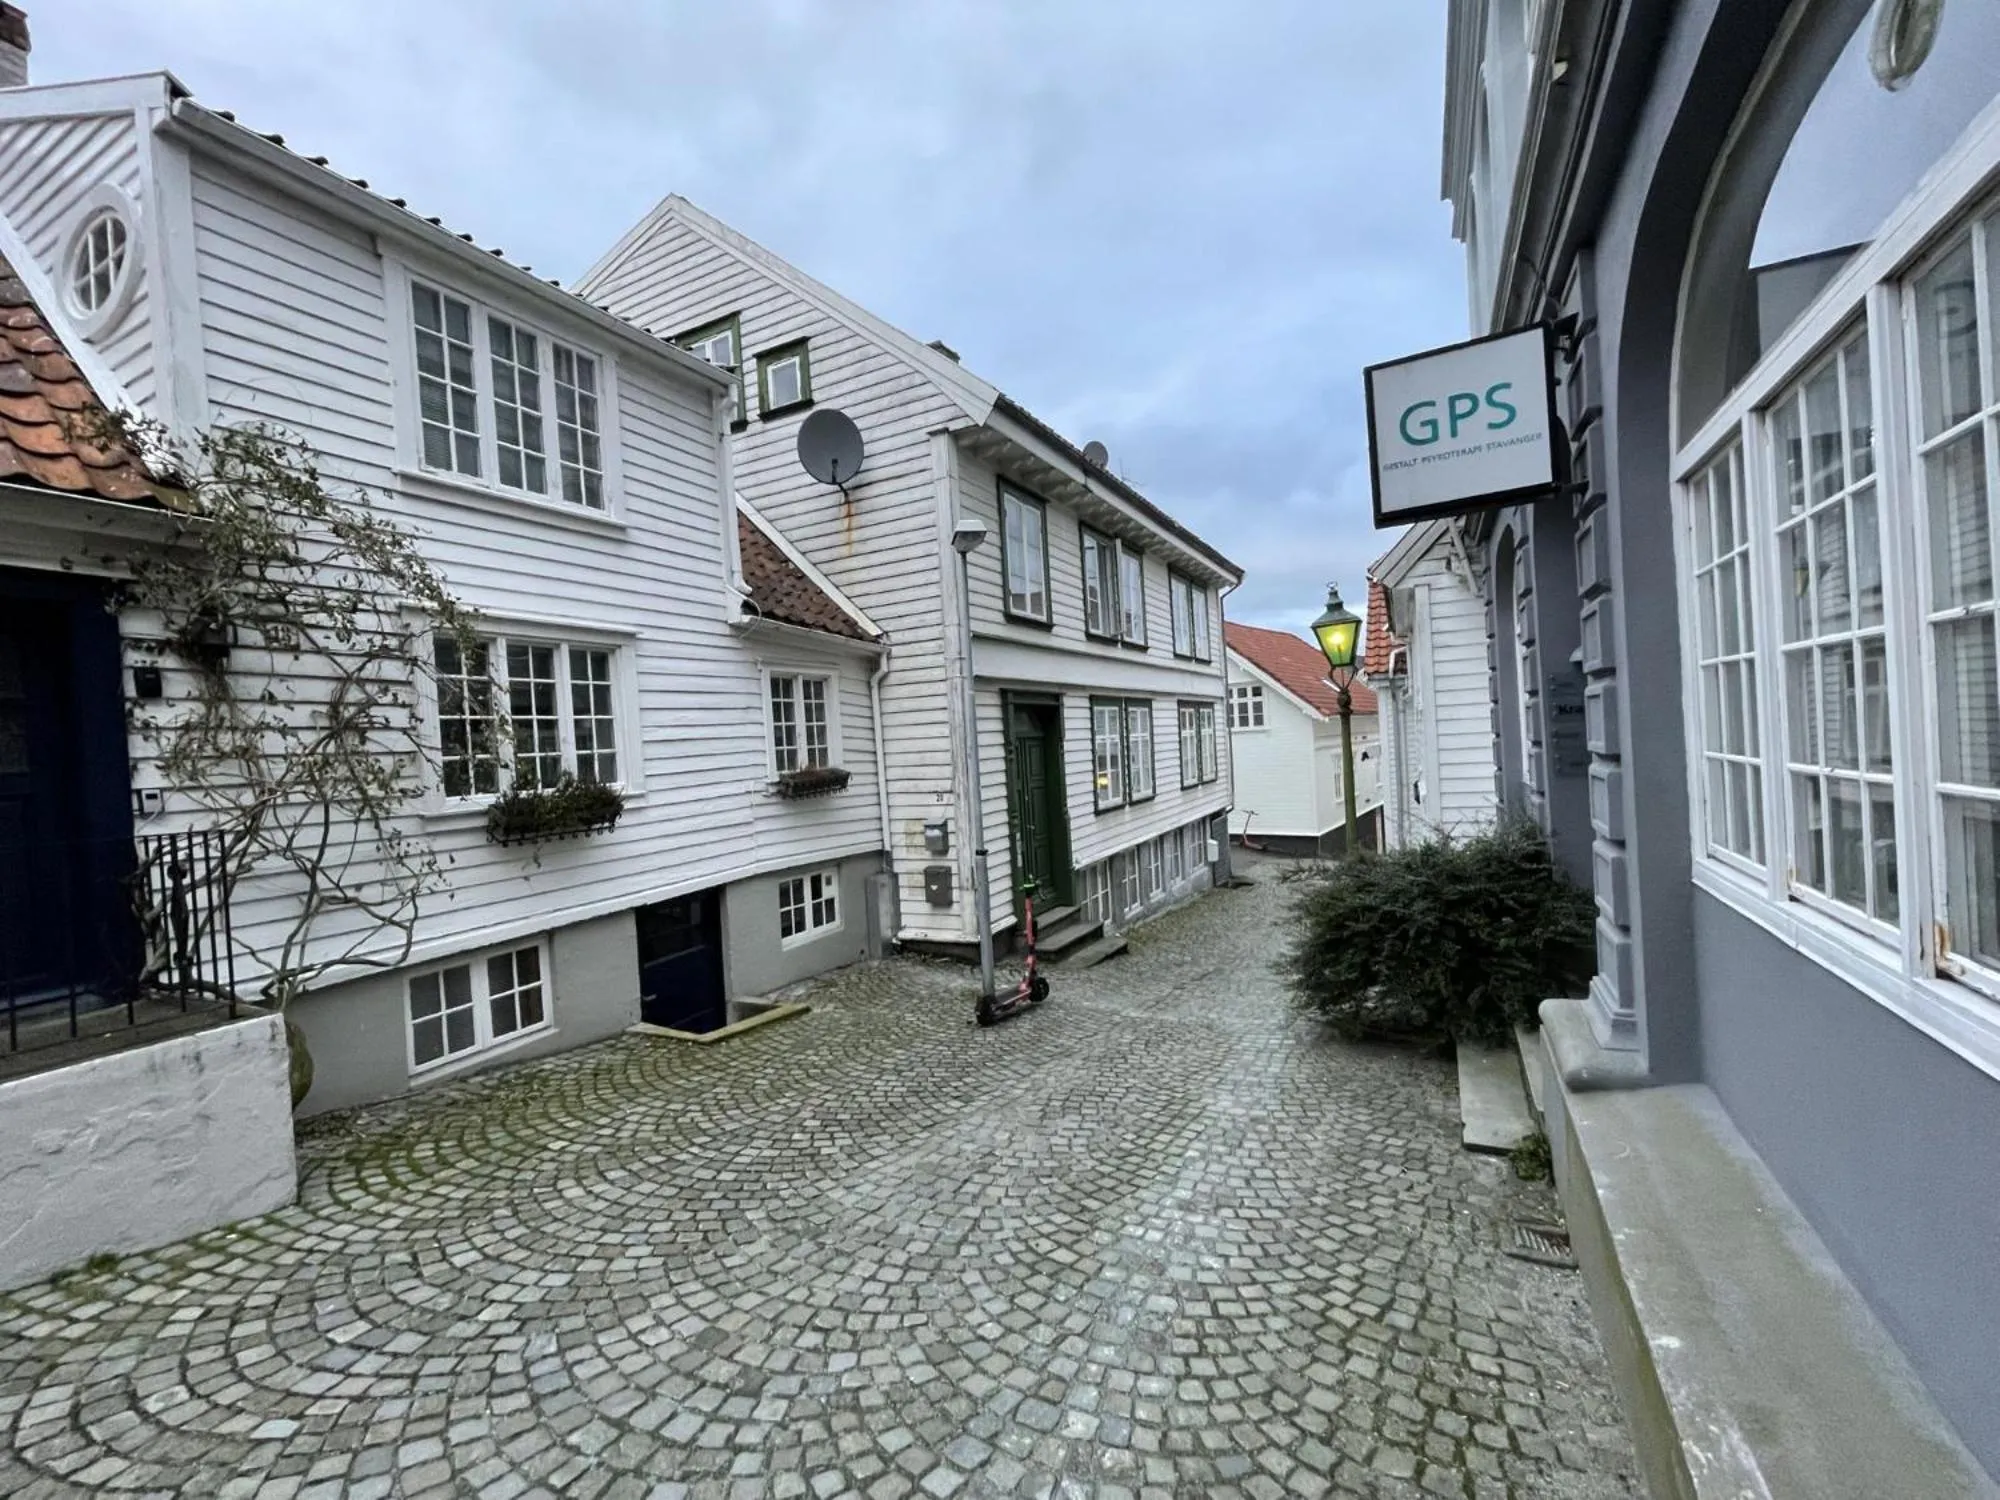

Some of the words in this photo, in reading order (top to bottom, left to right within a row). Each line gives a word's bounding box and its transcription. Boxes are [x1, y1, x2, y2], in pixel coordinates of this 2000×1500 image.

[1399, 382, 1517, 446] GPS
[1382, 457, 1418, 472] GESTALT
[1486, 431, 1543, 452] STAVANGER
